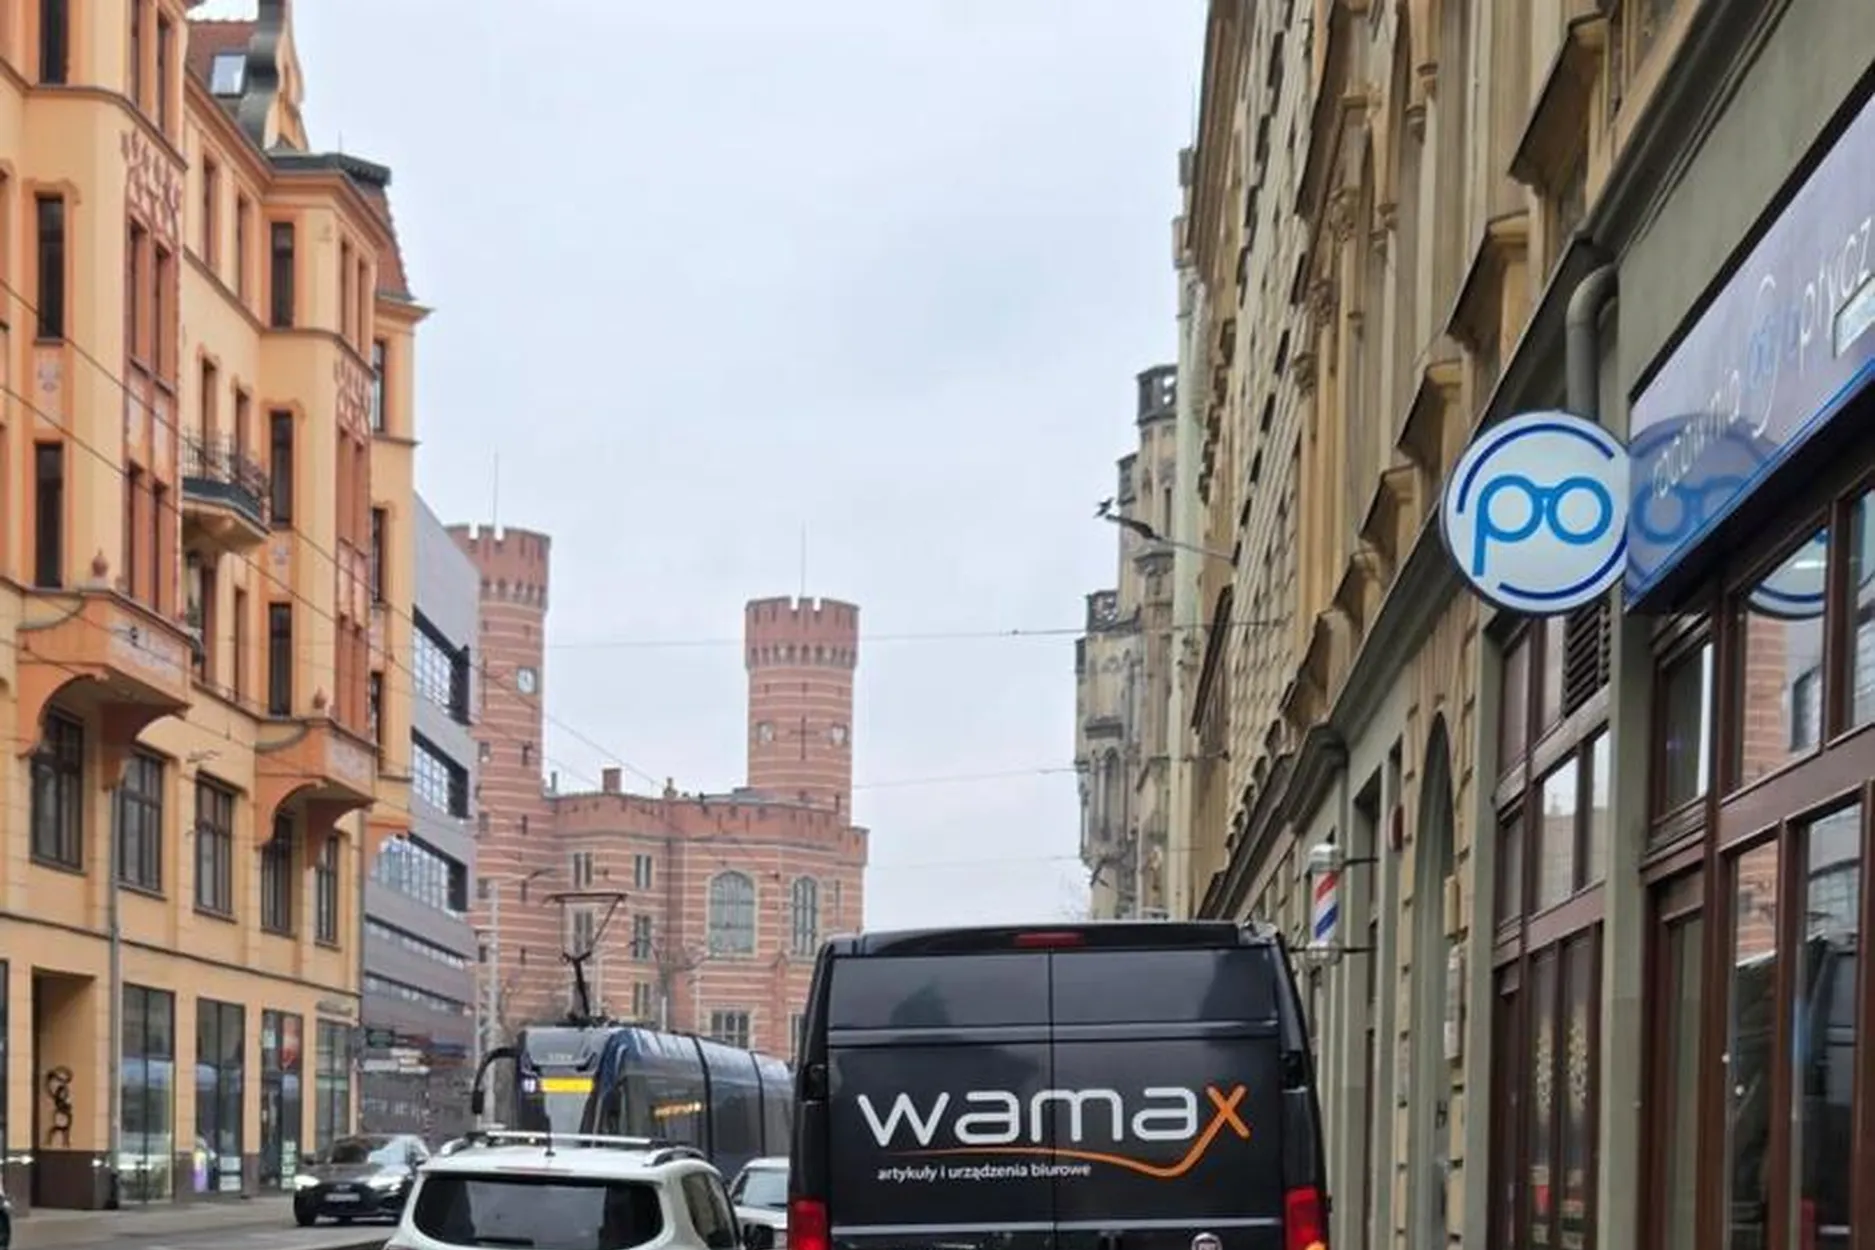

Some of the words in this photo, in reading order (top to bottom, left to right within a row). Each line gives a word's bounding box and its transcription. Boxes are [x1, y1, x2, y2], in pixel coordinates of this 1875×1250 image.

[1472, 474, 1613, 577] po
[858, 1084, 1250, 1147] wamax
[878, 1166, 937, 1182] artykuły
[940, 1165, 945, 1178] i
[949, 1164, 1027, 1180] urządzenia
[1031, 1163, 1092, 1177] biurowe
